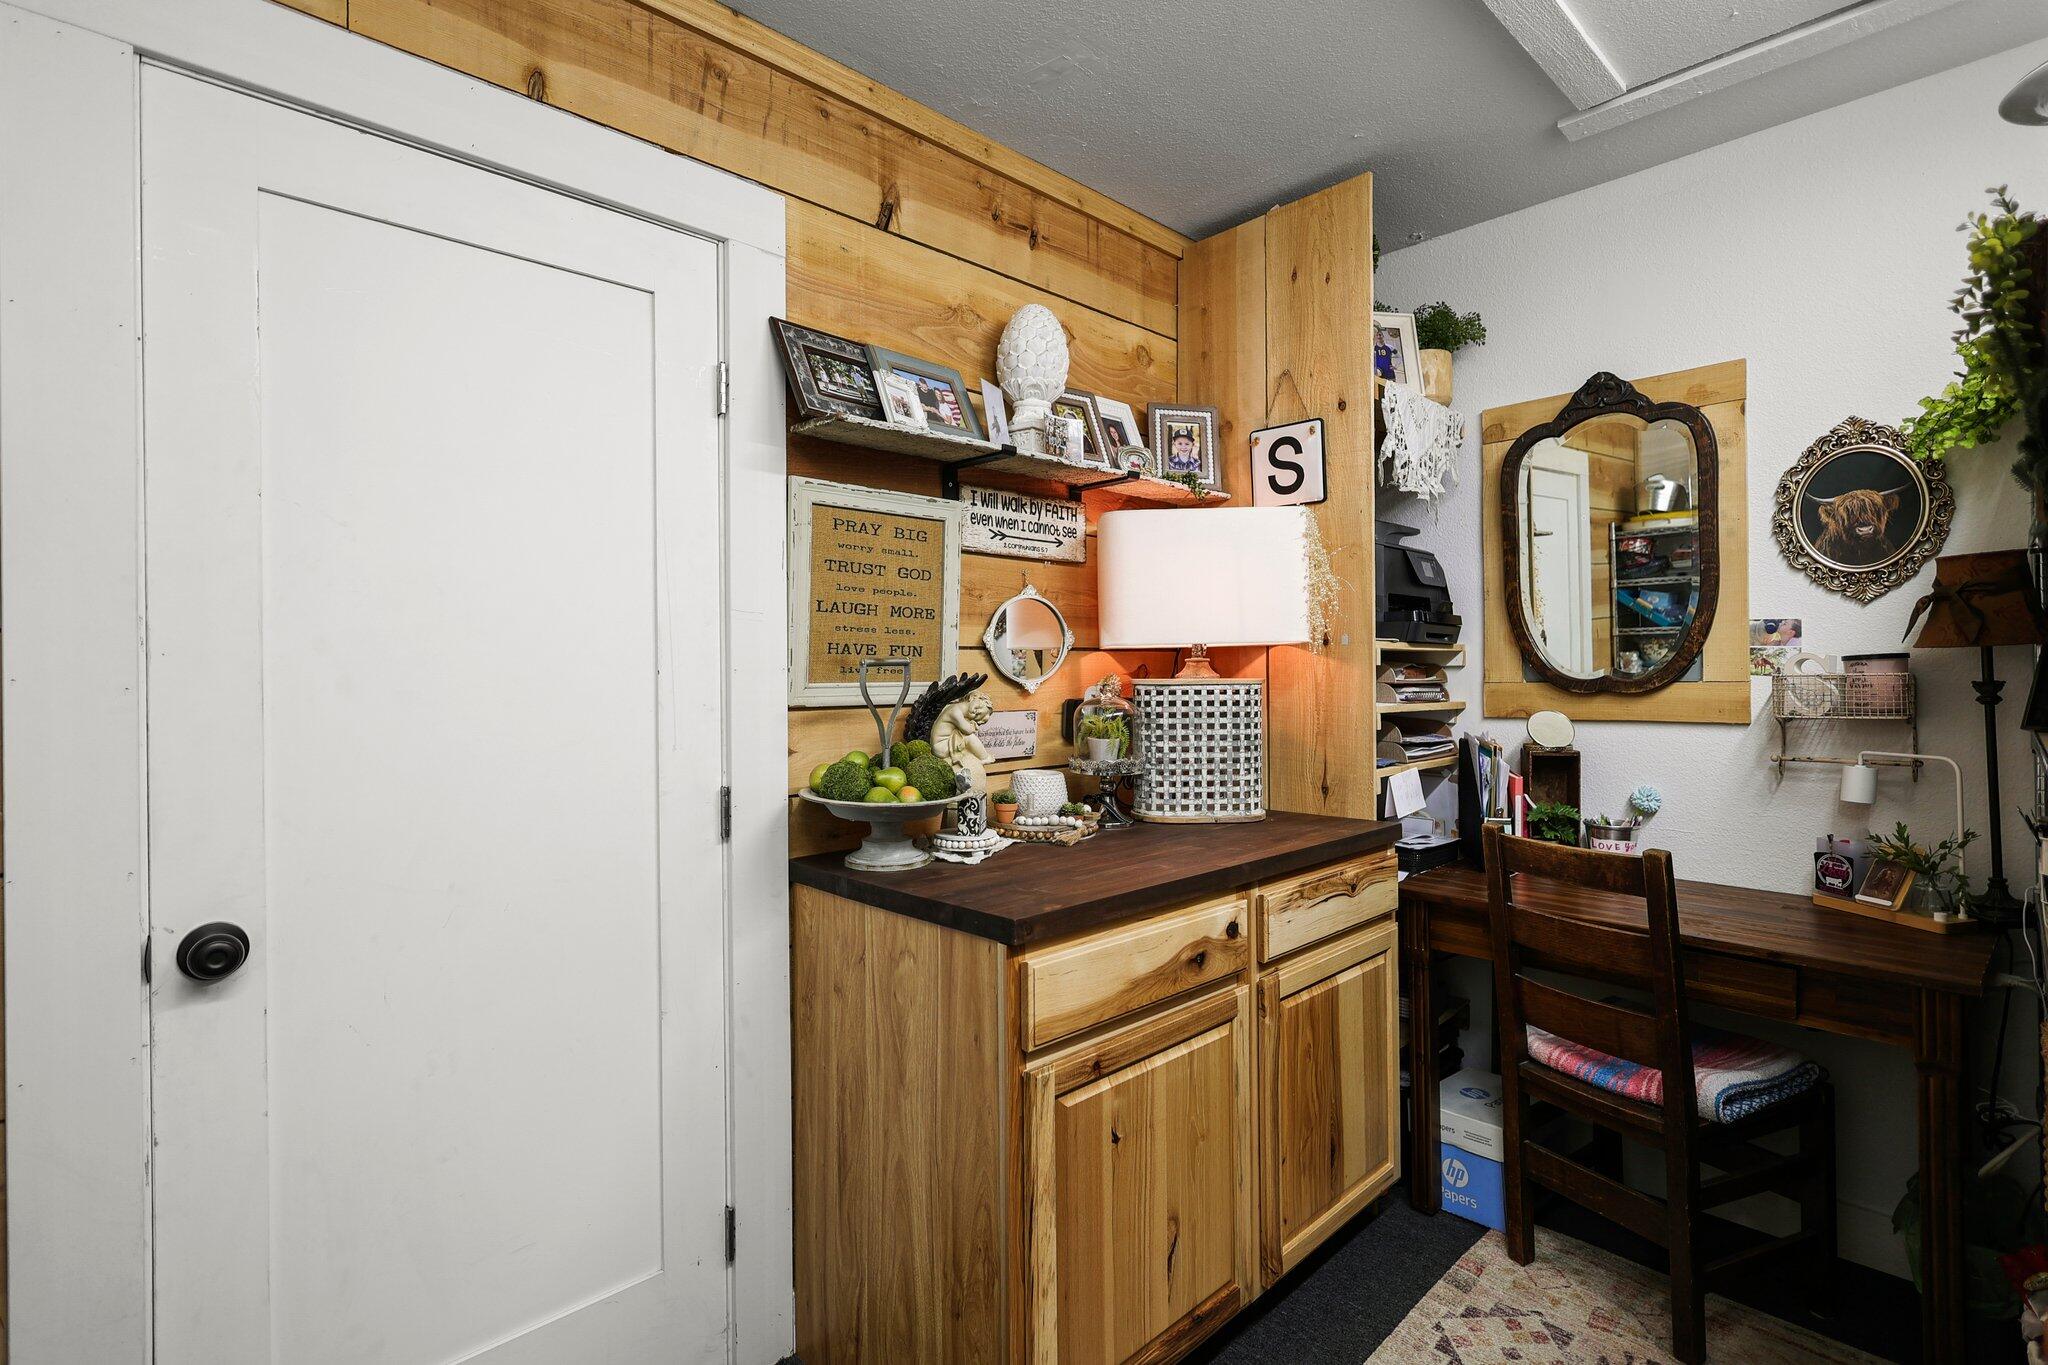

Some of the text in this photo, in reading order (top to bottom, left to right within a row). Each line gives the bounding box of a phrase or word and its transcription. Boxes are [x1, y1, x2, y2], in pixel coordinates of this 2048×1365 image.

[1268, 436, 1304, 495] S
[970, 490, 1078, 522] I will walk by FAITH
[833, 518, 928, 542] PRAY BIG
[970, 512, 1077, 539] even when I cannot see
[838, 542, 919, 558] worry small.
[824, 559, 932, 582] TRUST GOD
[836, 584, 917, 597] love people.
[816, 600, 935, 620] LAUGH MORE
[835, 625, 915, 635] stress less.
[827, 642, 923, 657] HAVE FUN
[1591, 838, 1620, 850] LOVE
[1440, 1125, 1456, 1134] pers
[1446, 1158, 1465, 1187] hp
[1441, 1187, 1477, 1209] apers
